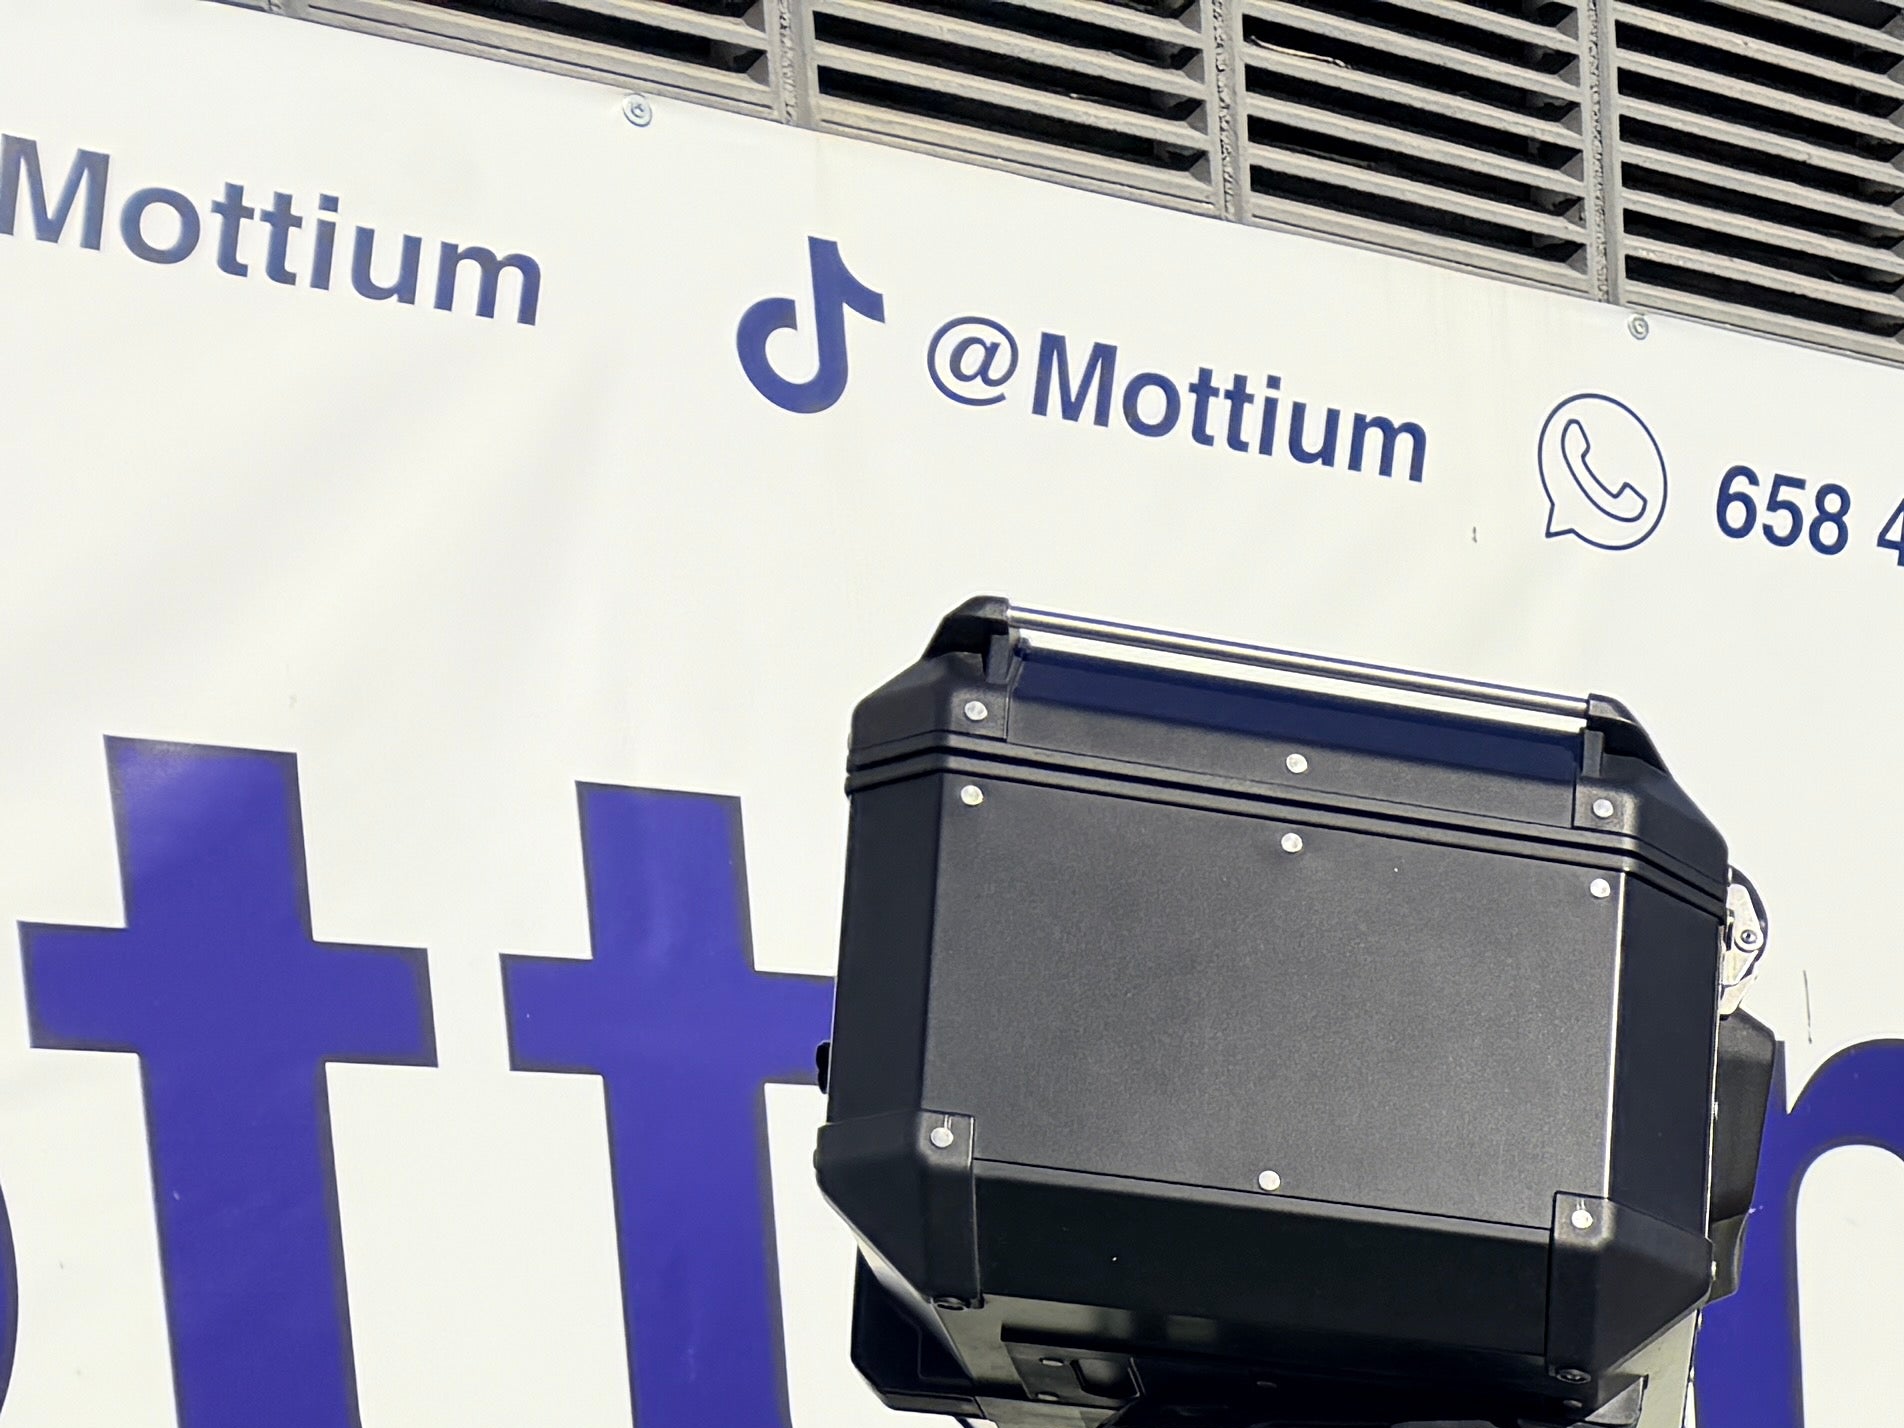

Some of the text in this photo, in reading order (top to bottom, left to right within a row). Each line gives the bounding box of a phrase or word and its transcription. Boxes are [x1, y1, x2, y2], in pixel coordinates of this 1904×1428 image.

[0, 136, 541, 326] Mottium
[926, 316, 1428, 482] @Mottium
[1715, 464, 1850, 555] 658
